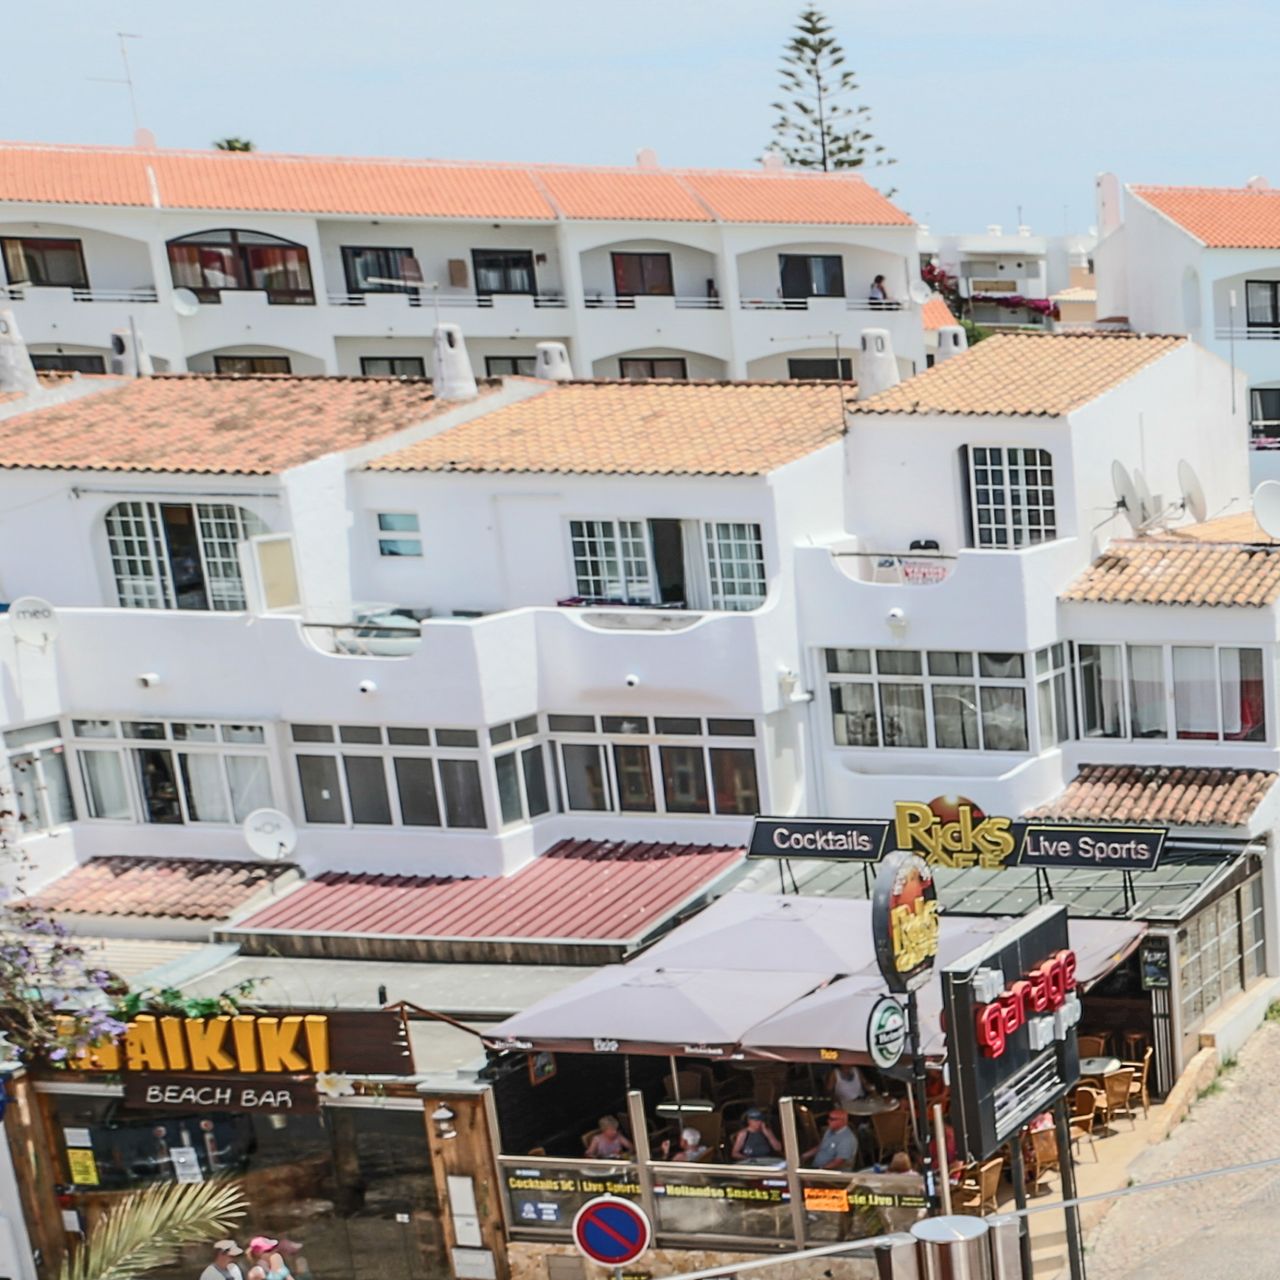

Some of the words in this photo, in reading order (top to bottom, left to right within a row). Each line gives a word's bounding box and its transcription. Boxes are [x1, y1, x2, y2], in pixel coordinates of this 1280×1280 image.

[773, 827, 873, 851] Cocktails
[1026, 836, 1071, 858] Live
[1079, 838, 1150, 863] Sports
[977, 951, 1077, 1058] garage
[146, 1086, 231, 1105] BEACH
[240, 1089, 292, 1108] BAR
[726, 1186, 769, 1200] Snacks
